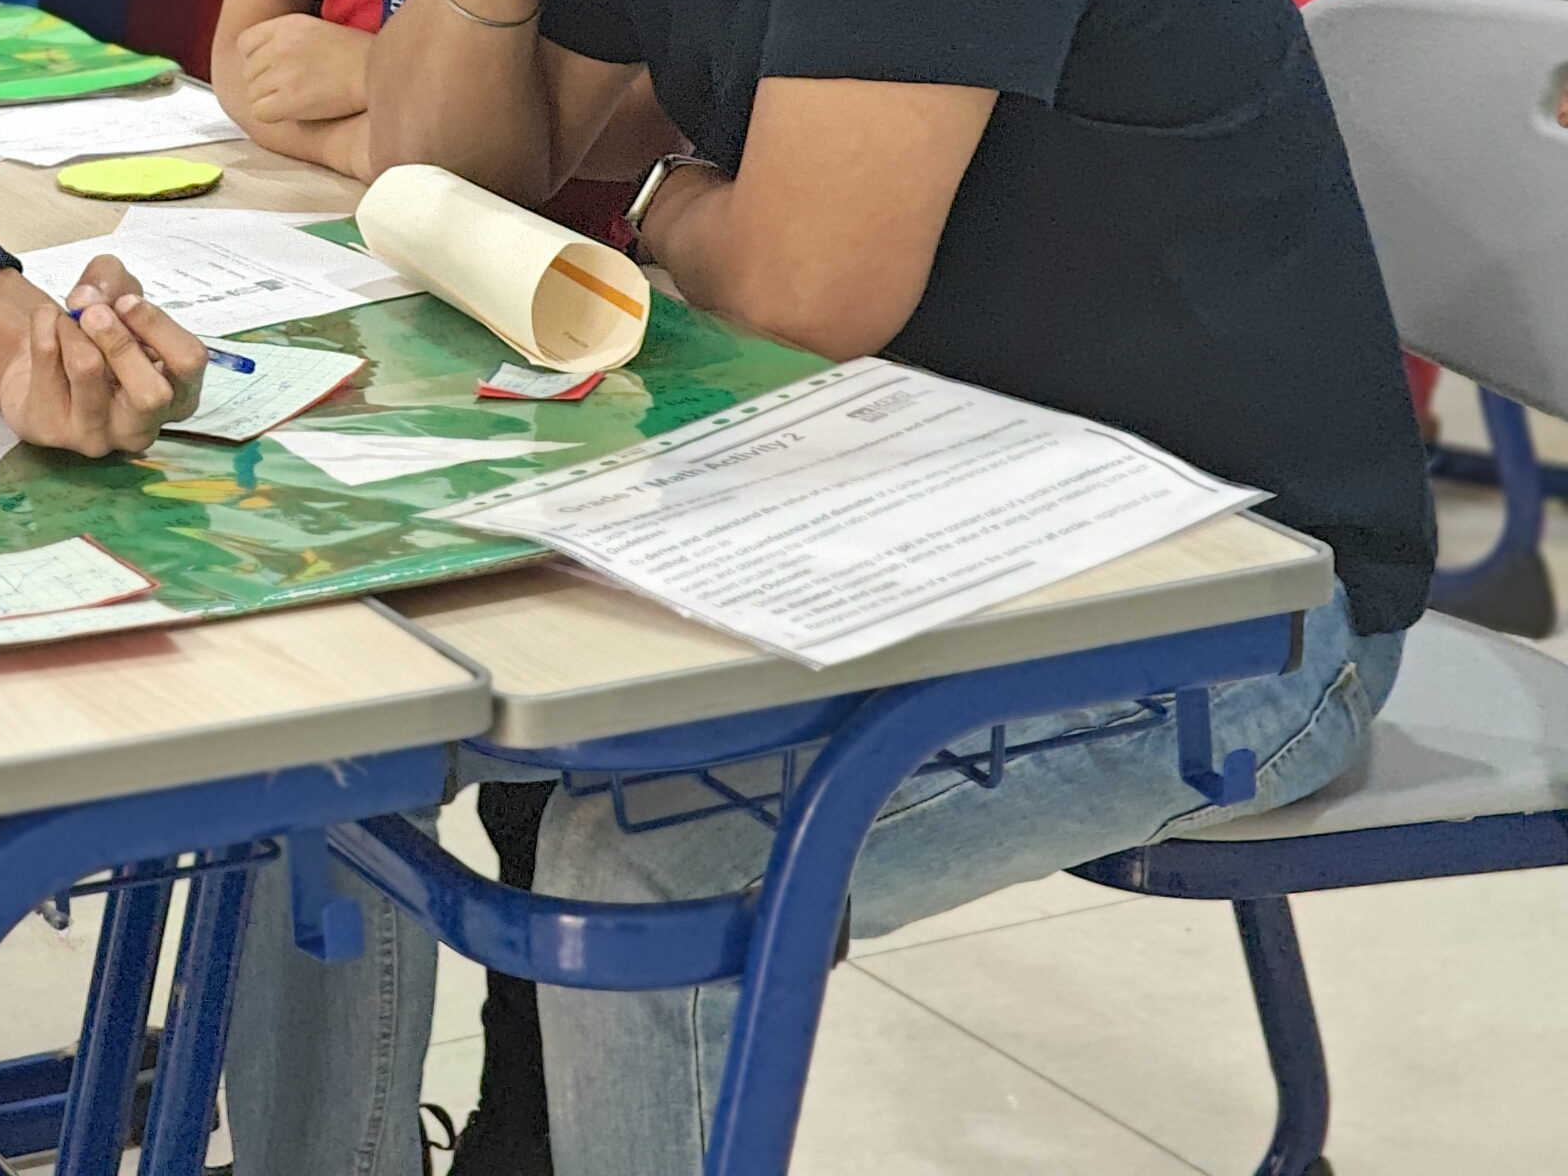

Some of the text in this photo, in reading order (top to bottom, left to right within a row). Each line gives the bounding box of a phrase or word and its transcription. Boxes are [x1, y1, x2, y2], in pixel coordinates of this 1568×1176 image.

[558, 432, 806, 513] Grade 7 Math Activity 2
